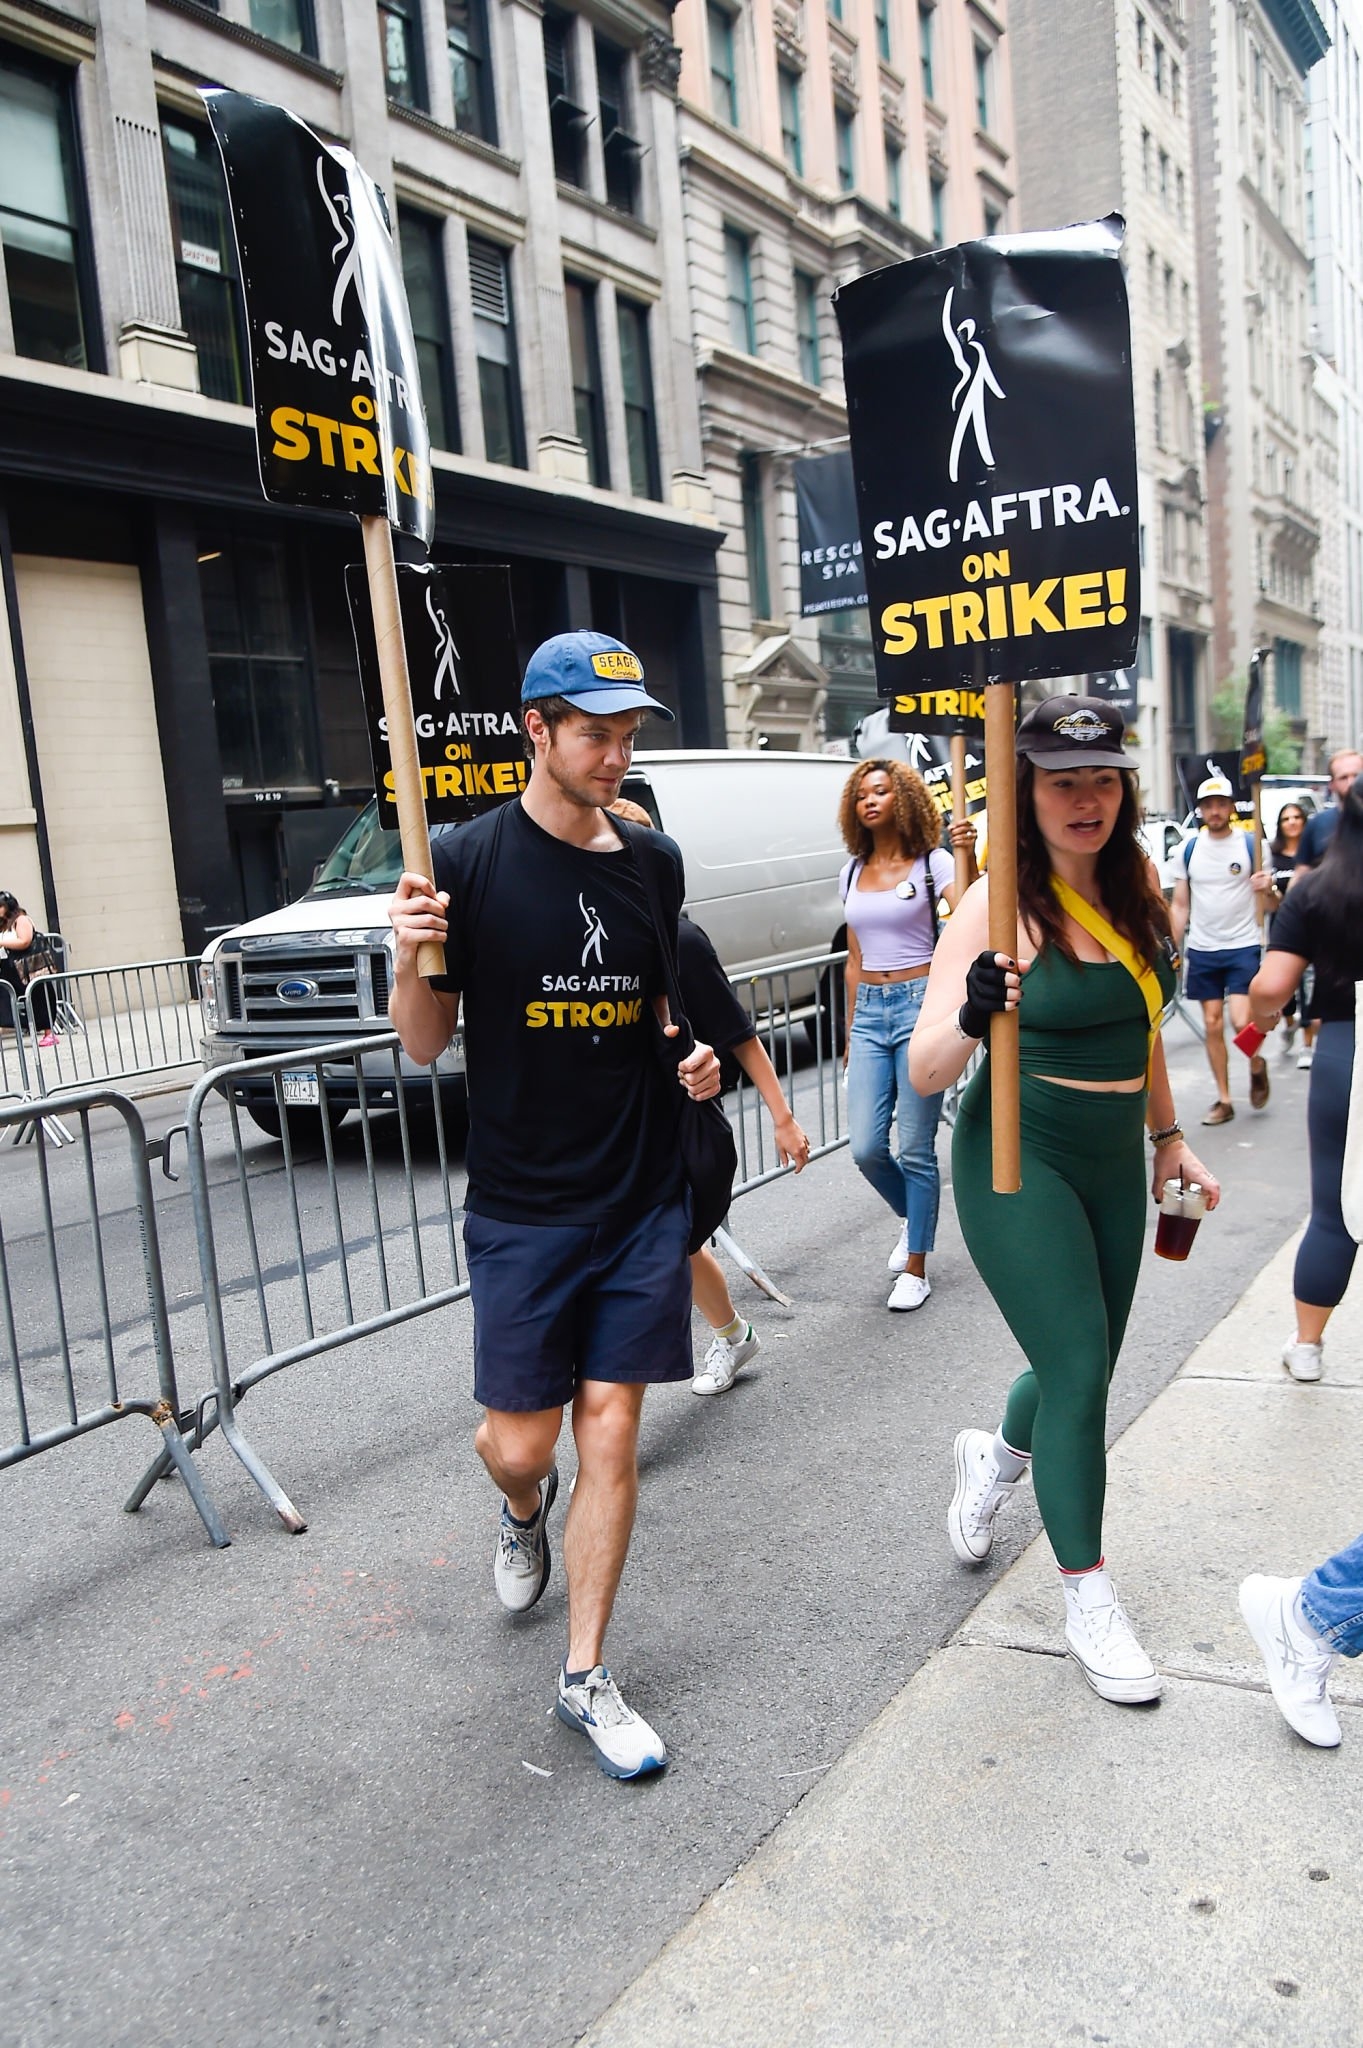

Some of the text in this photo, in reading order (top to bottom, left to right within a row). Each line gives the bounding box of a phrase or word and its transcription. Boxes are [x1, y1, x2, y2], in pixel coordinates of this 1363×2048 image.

[822, 560, 860, 580] SPA
[961, 549, 1011, 583] ON
[880, 568, 1128, 655] STRIKE!
[444, 743, 473, 761] ON
[255, 792, 264, 802] 19
[272, 792, 282, 801] 19
[525, 998, 642, 1028] STRONG
